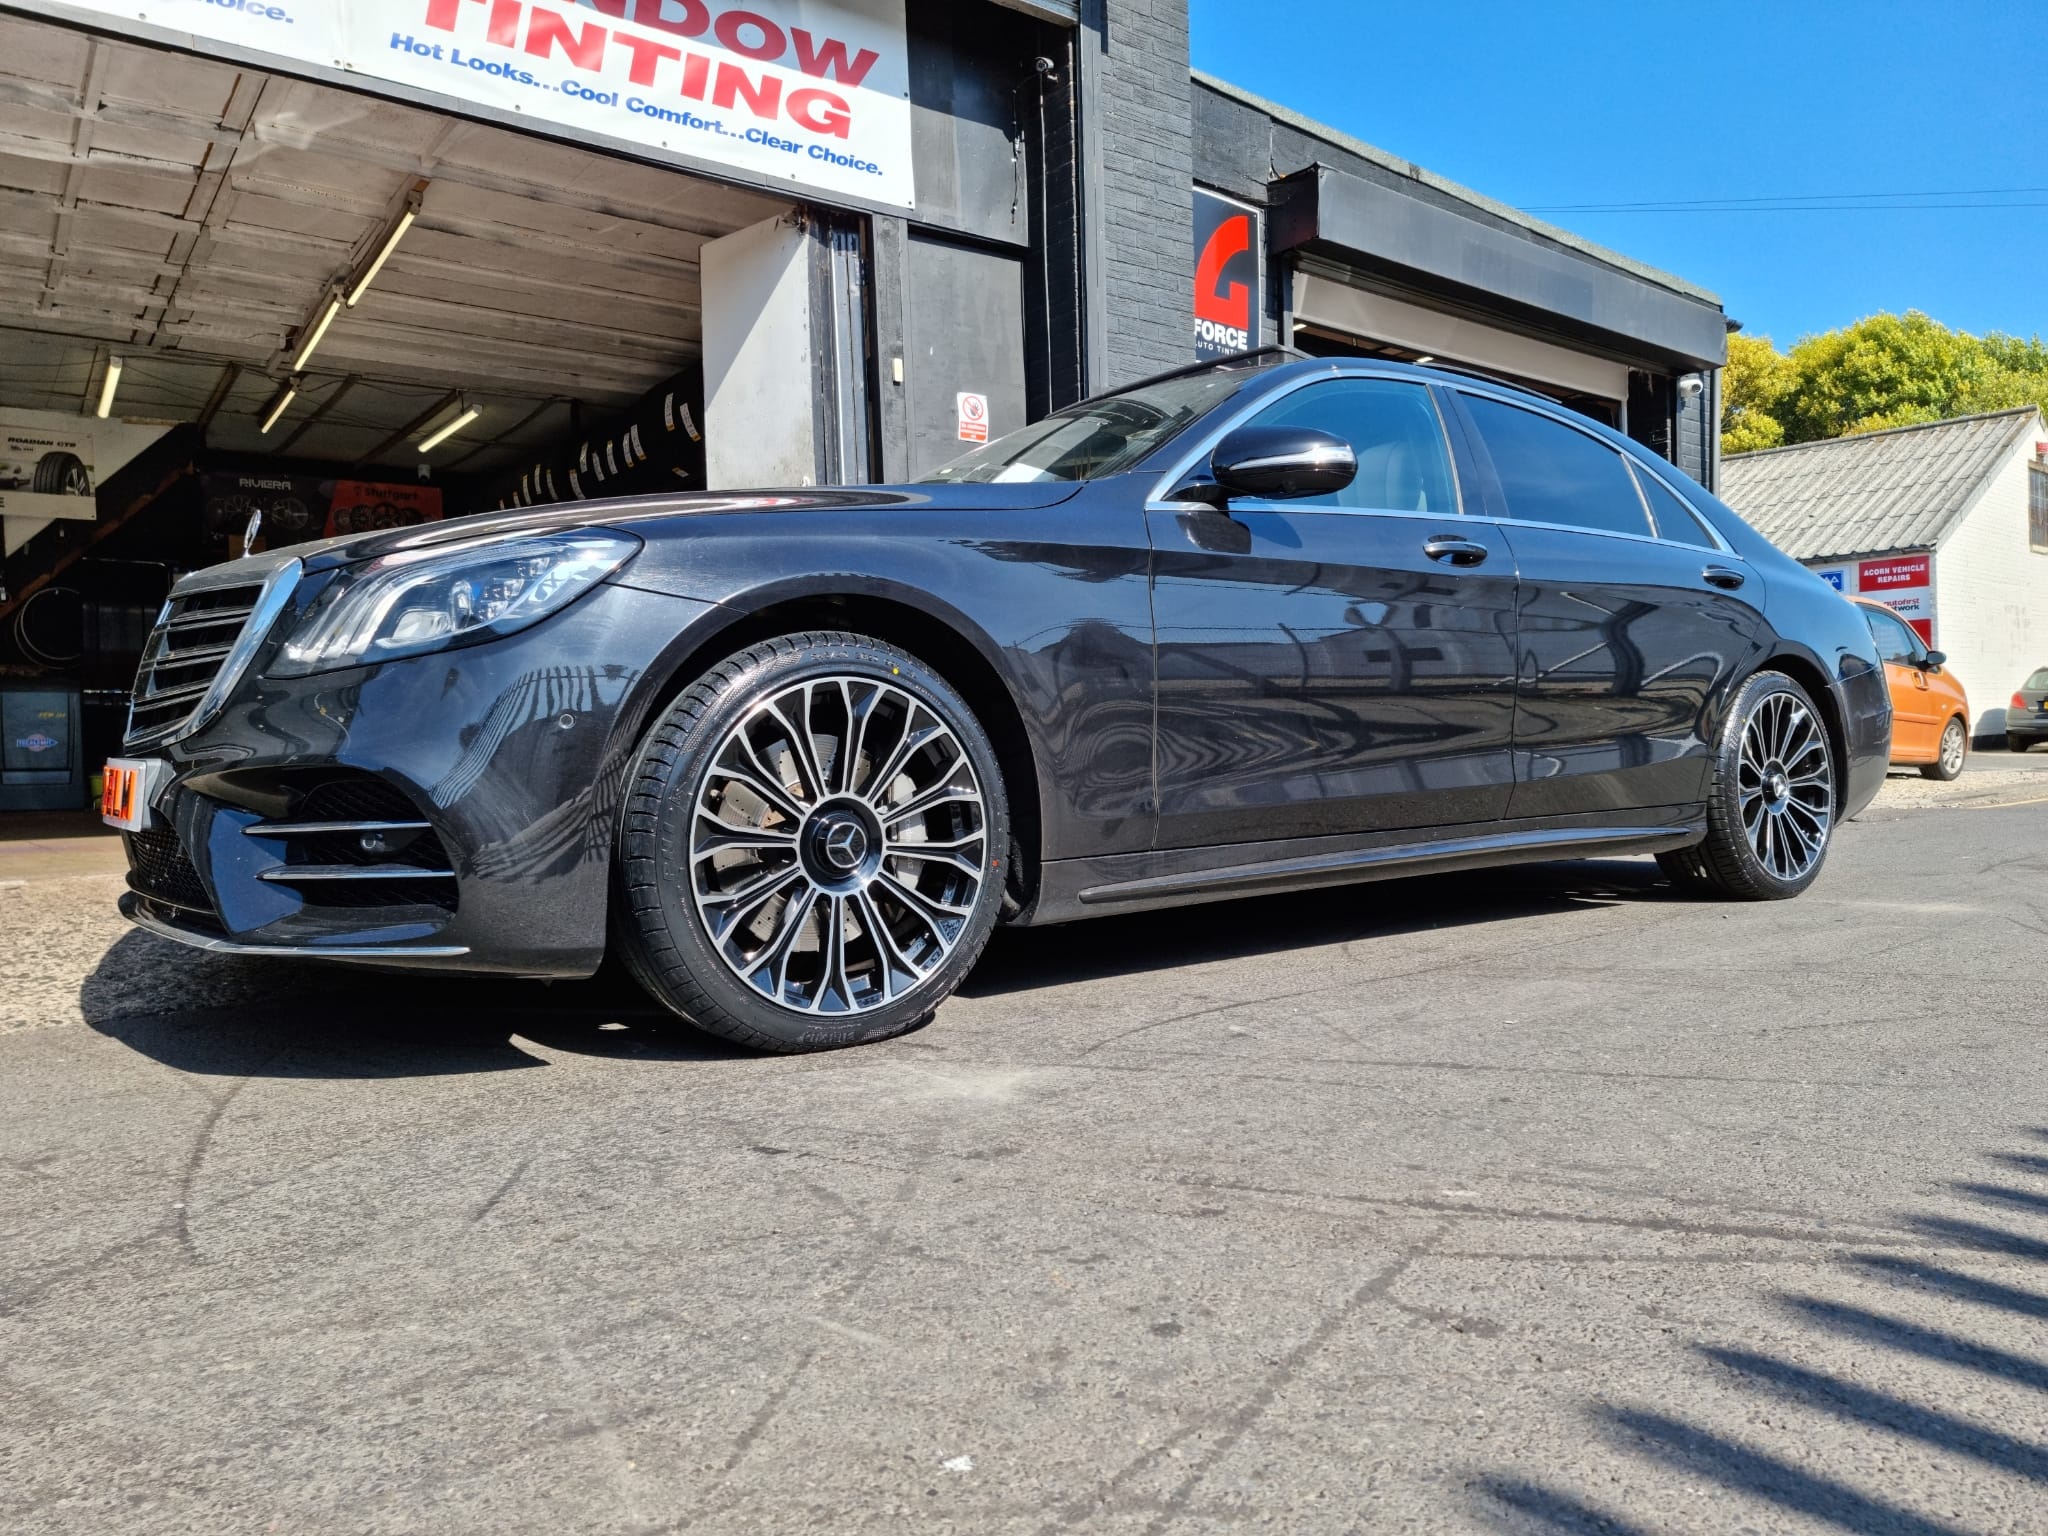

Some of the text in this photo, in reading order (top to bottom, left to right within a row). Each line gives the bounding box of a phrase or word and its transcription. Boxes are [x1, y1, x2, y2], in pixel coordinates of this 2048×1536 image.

[206, 0, 294, 24] oice.
[425, 0, 851, 139] TINTING
[390, 32, 443, 60] Hot
[807, 144, 884, 176] Choice.
[1194, 318, 1248, 350] FORCE
[1195, 339, 1238, 356] UTO TINT
[7, 437, 54, 446] ROADIAN
[239, 478, 292, 490] RIVIERA
[1864, 564, 1925, 577] ACORN VEHICLE
[1878, 574, 1911, 583] REPAIRS
